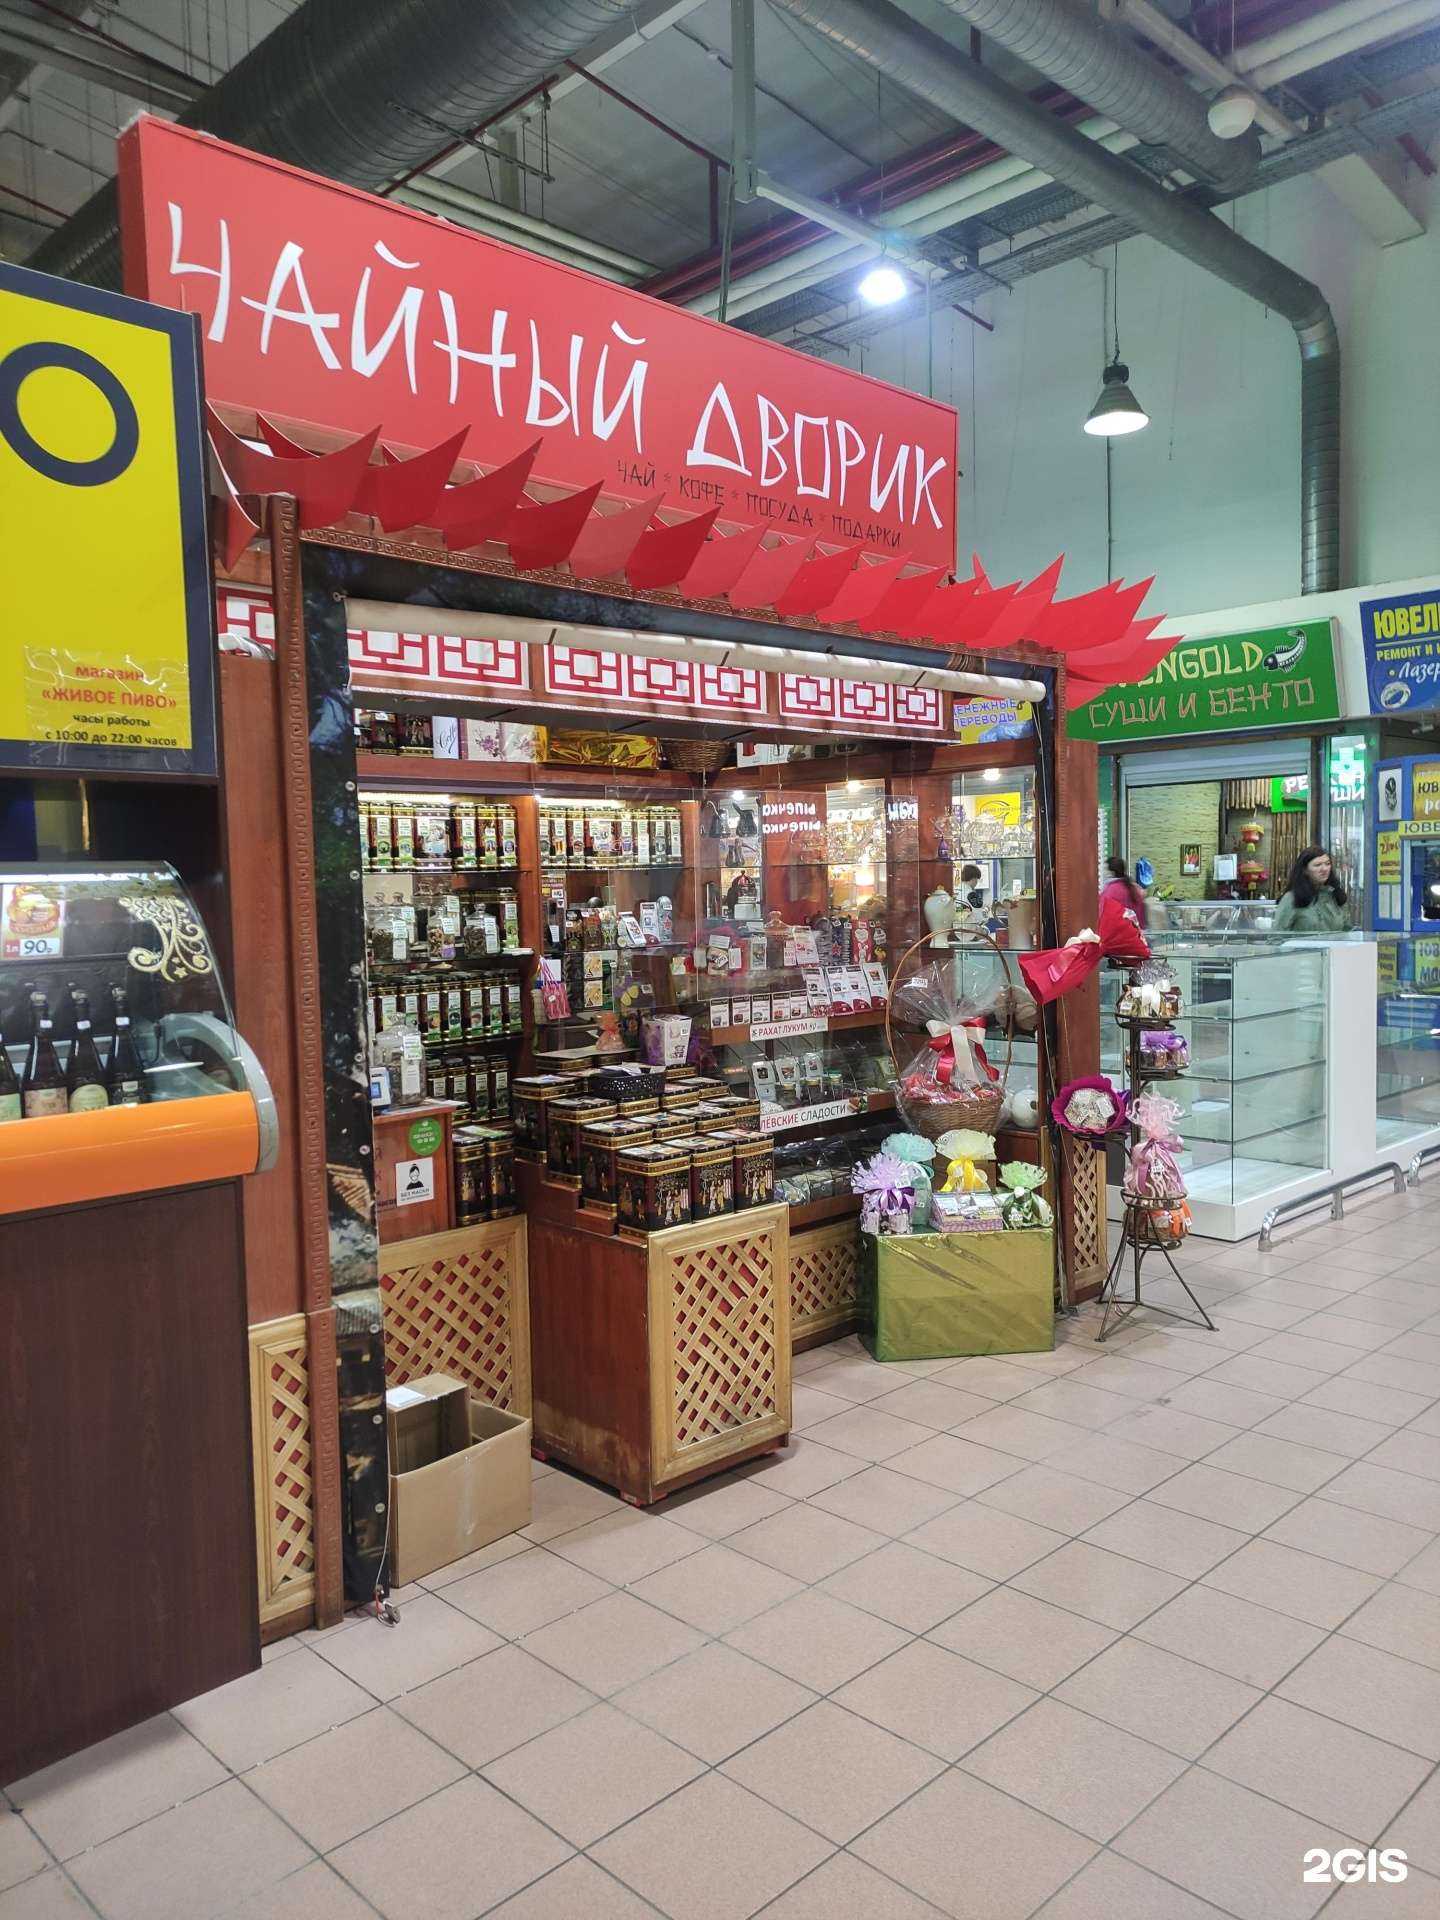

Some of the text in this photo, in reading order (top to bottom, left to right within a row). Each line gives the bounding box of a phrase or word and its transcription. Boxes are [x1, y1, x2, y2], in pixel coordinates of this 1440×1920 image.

[168, 201, 947, 529] ЧАЙНЫЙ ДВОРИК
[617, 460, 902, 547] ЧАЙ КОФЕ ПОСУДА ПОДАРКИ
[1376, 645, 1422, 661] РЕМОНТ
[75, 665, 145, 682] магазин
[42, 686, 177, 709] «ЖИВОЕ ПИВО»
[1089, 677, 1316, 729] СУШИ И БЕНТО
[73, 714, 151, 727] часы работы
[56, 730, 89, 742] 10:00
[92, 734, 107, 745] до
[112, 734, 142, 745] 22:00
[145, 737, 177, 747] часов
[759, 1022, 808, 1037] РАХАТ ЛУКУМ
[801, 1104, 846, 1122] СЛАДОСТИ
